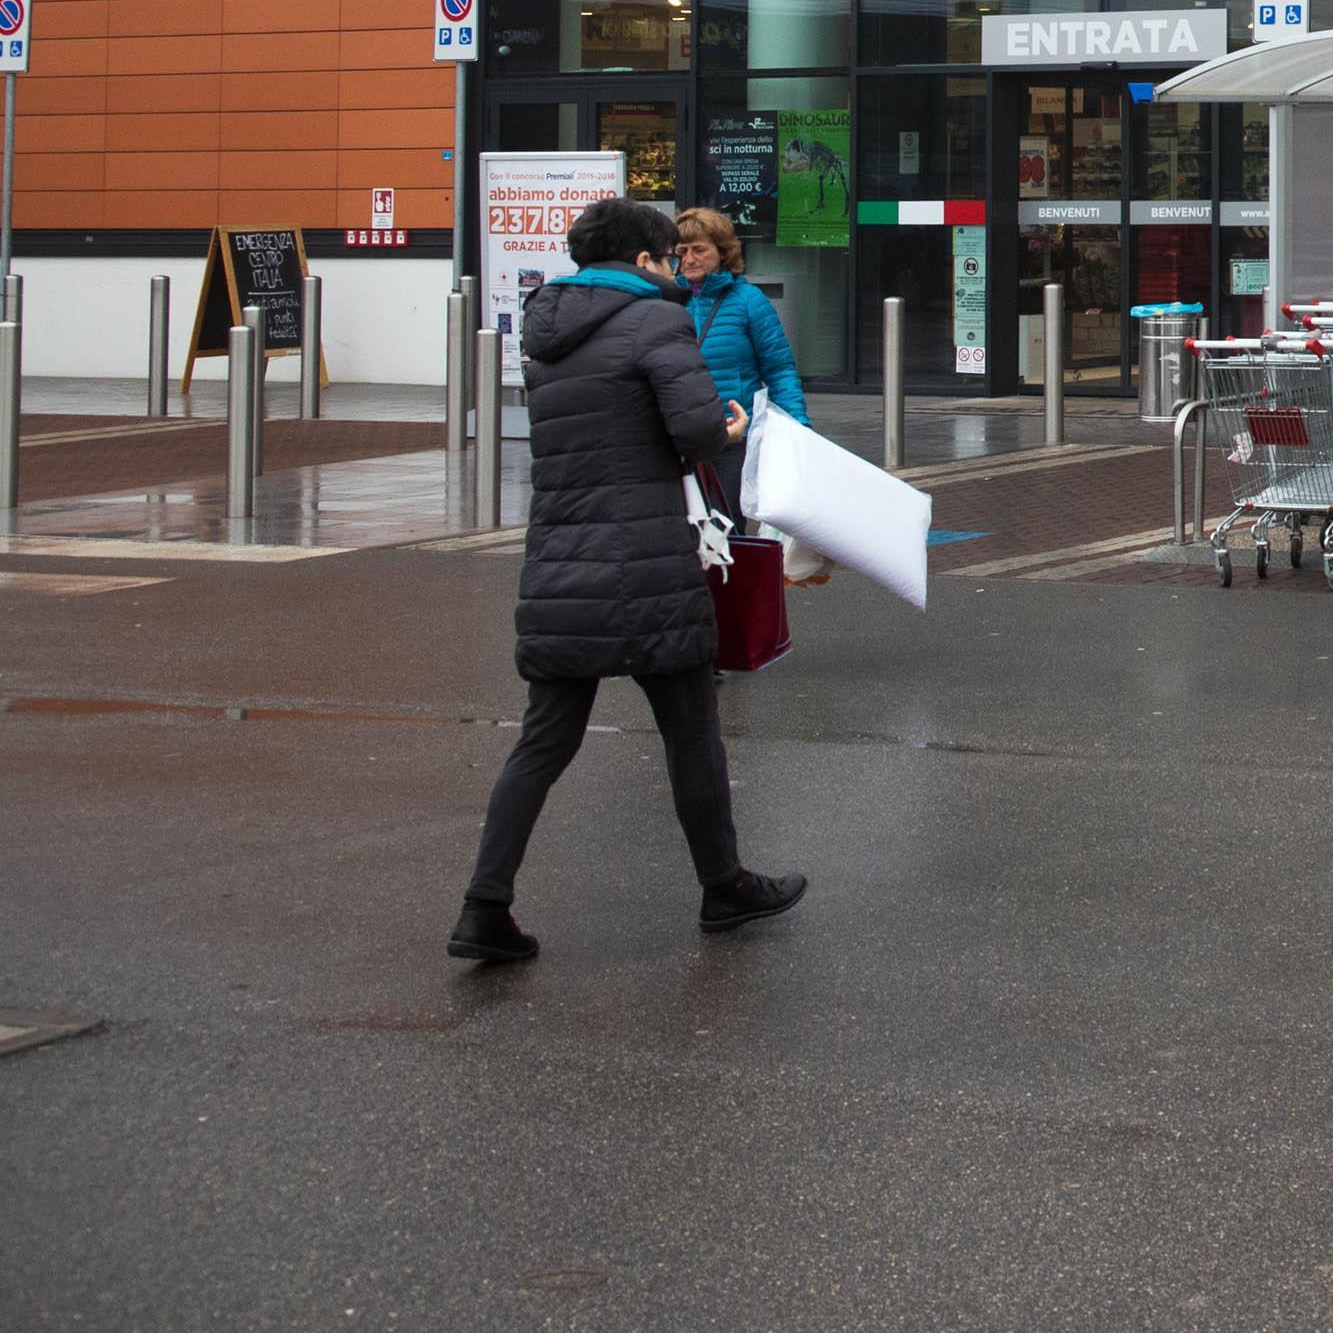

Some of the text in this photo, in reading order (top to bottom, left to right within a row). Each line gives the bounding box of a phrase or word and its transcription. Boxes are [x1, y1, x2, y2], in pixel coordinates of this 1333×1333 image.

[1007, 18, 1200, 57] ENTRATA
[709, 144, 773, 154] sci in notturna
[489, 187, 617, 201] abbiamo donato
[729, 183, 753, 194] 12,00
[1038, 207, 1100, 218] BENVENUTI
[1151, 206, 1211, 218] BENVENUT
[235, 232, 296, 251] EMERGENZA
[504, 241, 545, 251] GRAZIE
[548, 241, 558, 251] A
[248, 250, 285, 268] CENTRO
